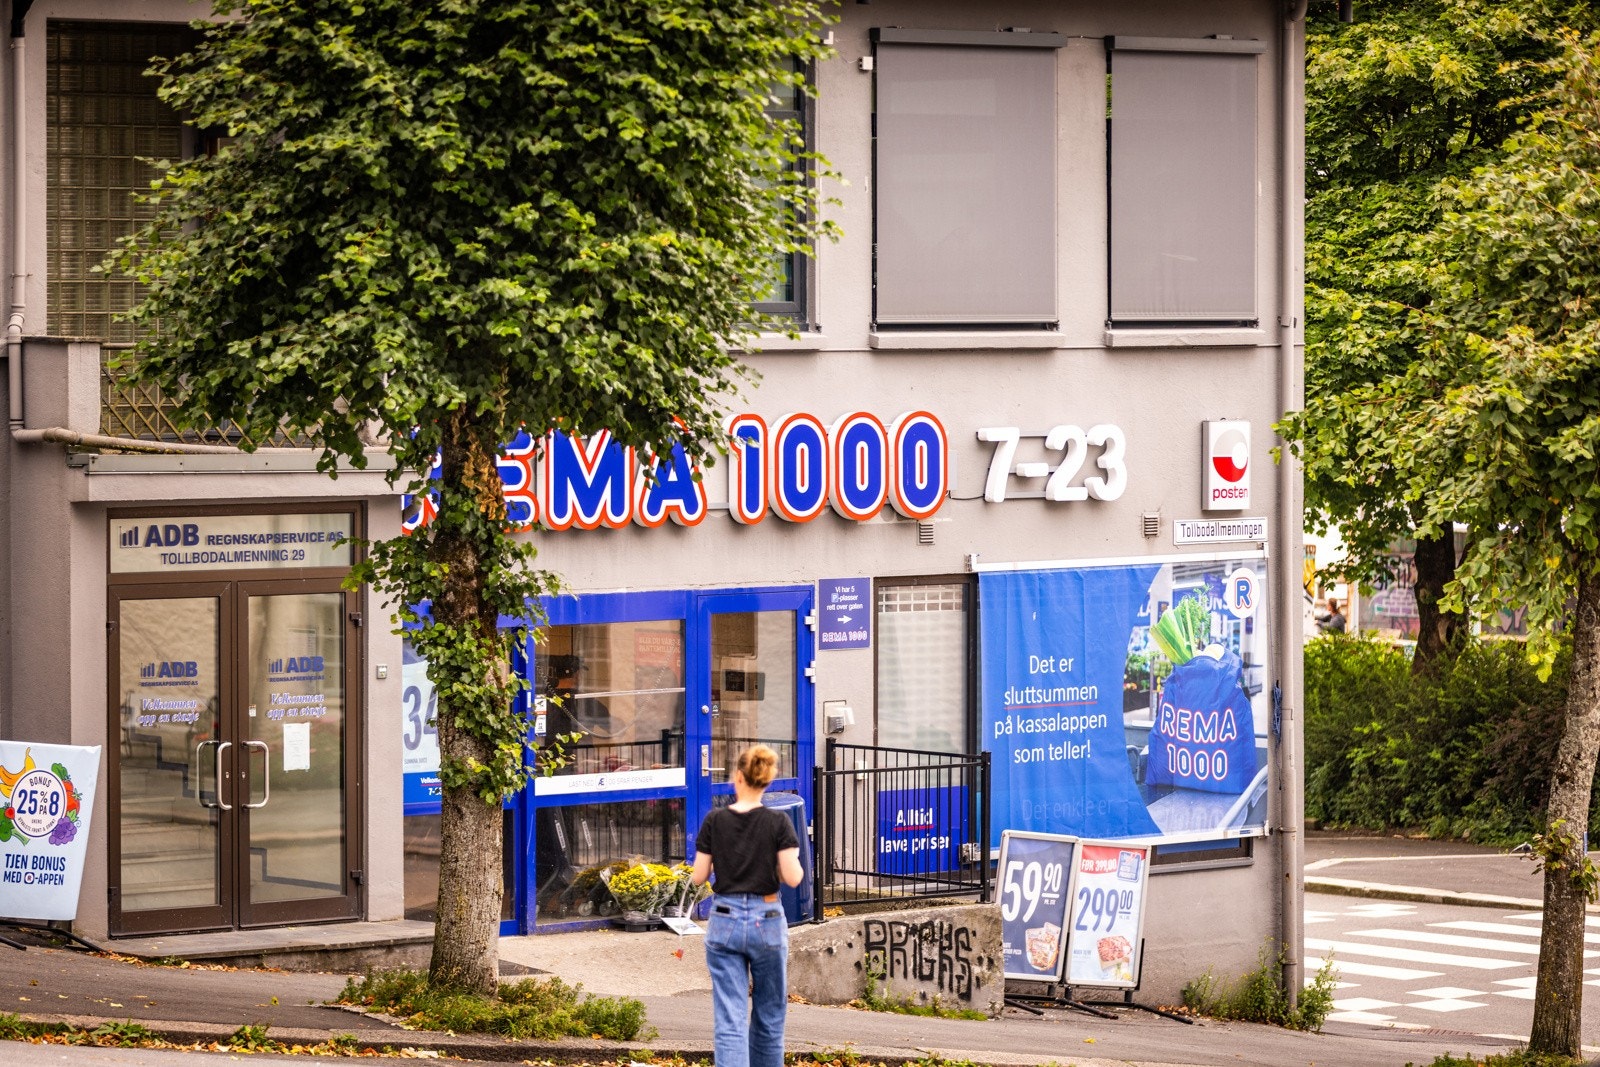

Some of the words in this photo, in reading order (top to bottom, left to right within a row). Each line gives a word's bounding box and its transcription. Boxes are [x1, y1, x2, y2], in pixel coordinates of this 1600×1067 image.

[400, 413, 706, 535] EMA
[723, 410, 948, 525] 1000
[977, 423, 1128, 503] 7-23
[1212, 486, 1248, 501] posten
[144, 523, 201, 548] ADB
[207, 531, 325, 546] REGNSKAPSERVICE
[327, 531, 344, 543] AS
[1180, 521, 1263, 538] Tollbodallmenningen
[160, 549, 289, 566] TOLLBODALMENNING
[291, 549, 306, 562] 29
[1234, 576, 1252, 610] R
[822, 631, 848, 643] REMA
[158, 661, 199, 678] ADB
[286, 656, 325, 673] ADB
[1029, 655, 1056, 674] Det
[1059, 657, 1074, 673] er
[1004, 685, 1098, 706] sluttsummen
[994, 715, 1013, 739] på
[1017, 712, 1107, 735] kassalappen
[1160, 703, 1238, 744] REMA
[1014, 746, 1045, 764] som
[1049, 739, 1091, 761] teller!
[1166, 743, 1228, 781] 1000
[29, 776, 52, 788] BONUS
[17, 789, 39, 815] 25
[48, 790, 60, 816] 8
[895, 807, 933, 826] Alltid
[880, 836, 908, 854] lave
[911, 832, 950, 855] priser
[5, 853, 29, 870] TJEN
[31, 855, 66, 872] BONUS
[3, 870, 21, 883] MED
[1002, 860, 1043, 923] 59
[1043, 862, 1063, 892] 90
[1075, 886, 1120, 933] 299
[1119, 889, 1134, 910] 00
